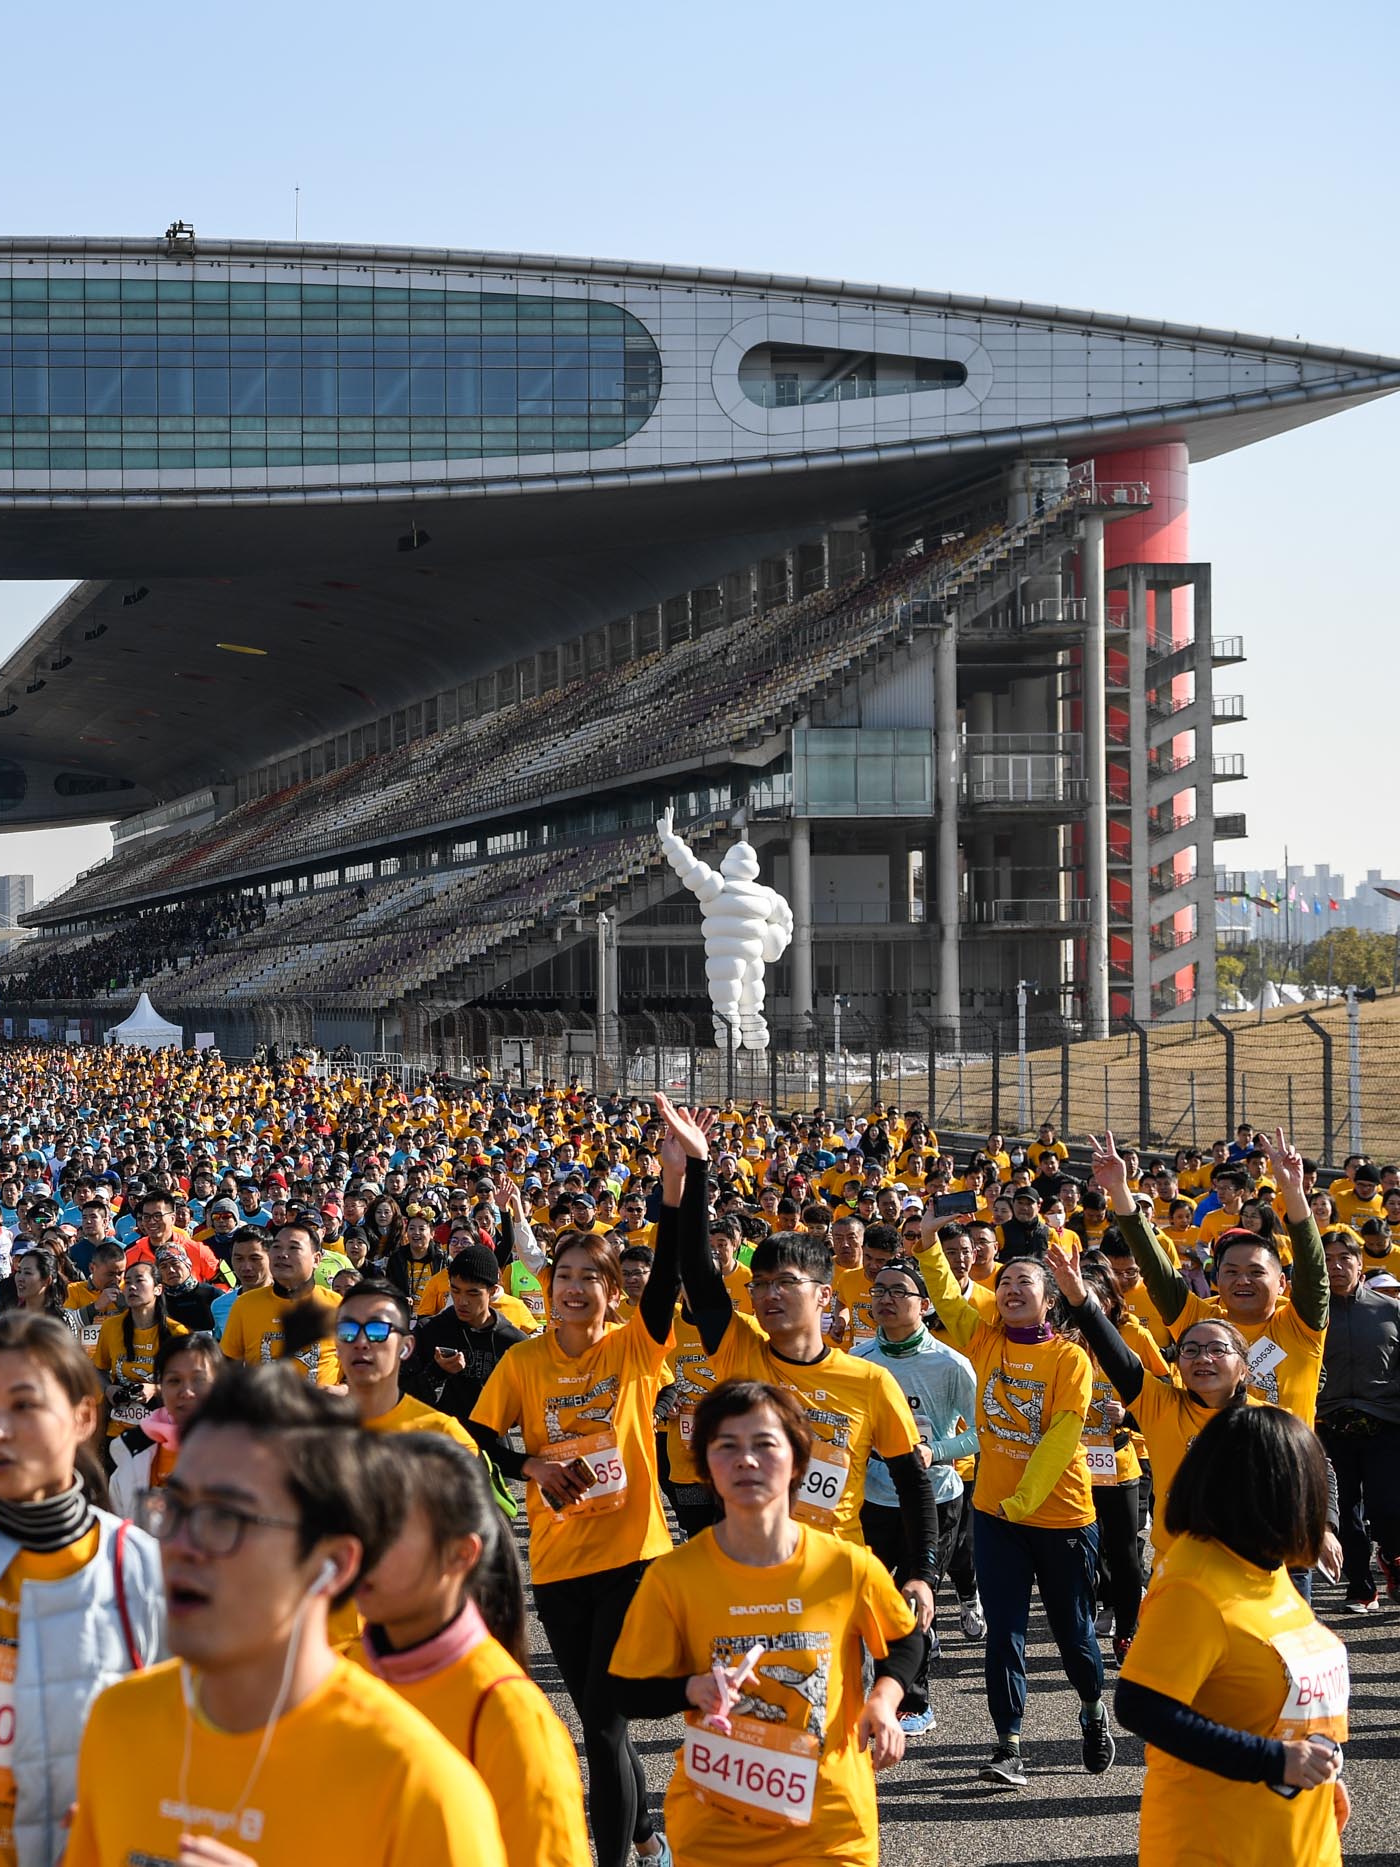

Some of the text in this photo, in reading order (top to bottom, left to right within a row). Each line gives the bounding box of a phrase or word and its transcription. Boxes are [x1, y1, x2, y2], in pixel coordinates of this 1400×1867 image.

[1247, 1343, 1277, 1372] B30538
[729, 1603, 785, 1615] salomon
[692, 1744, 808, 1804] B41665
